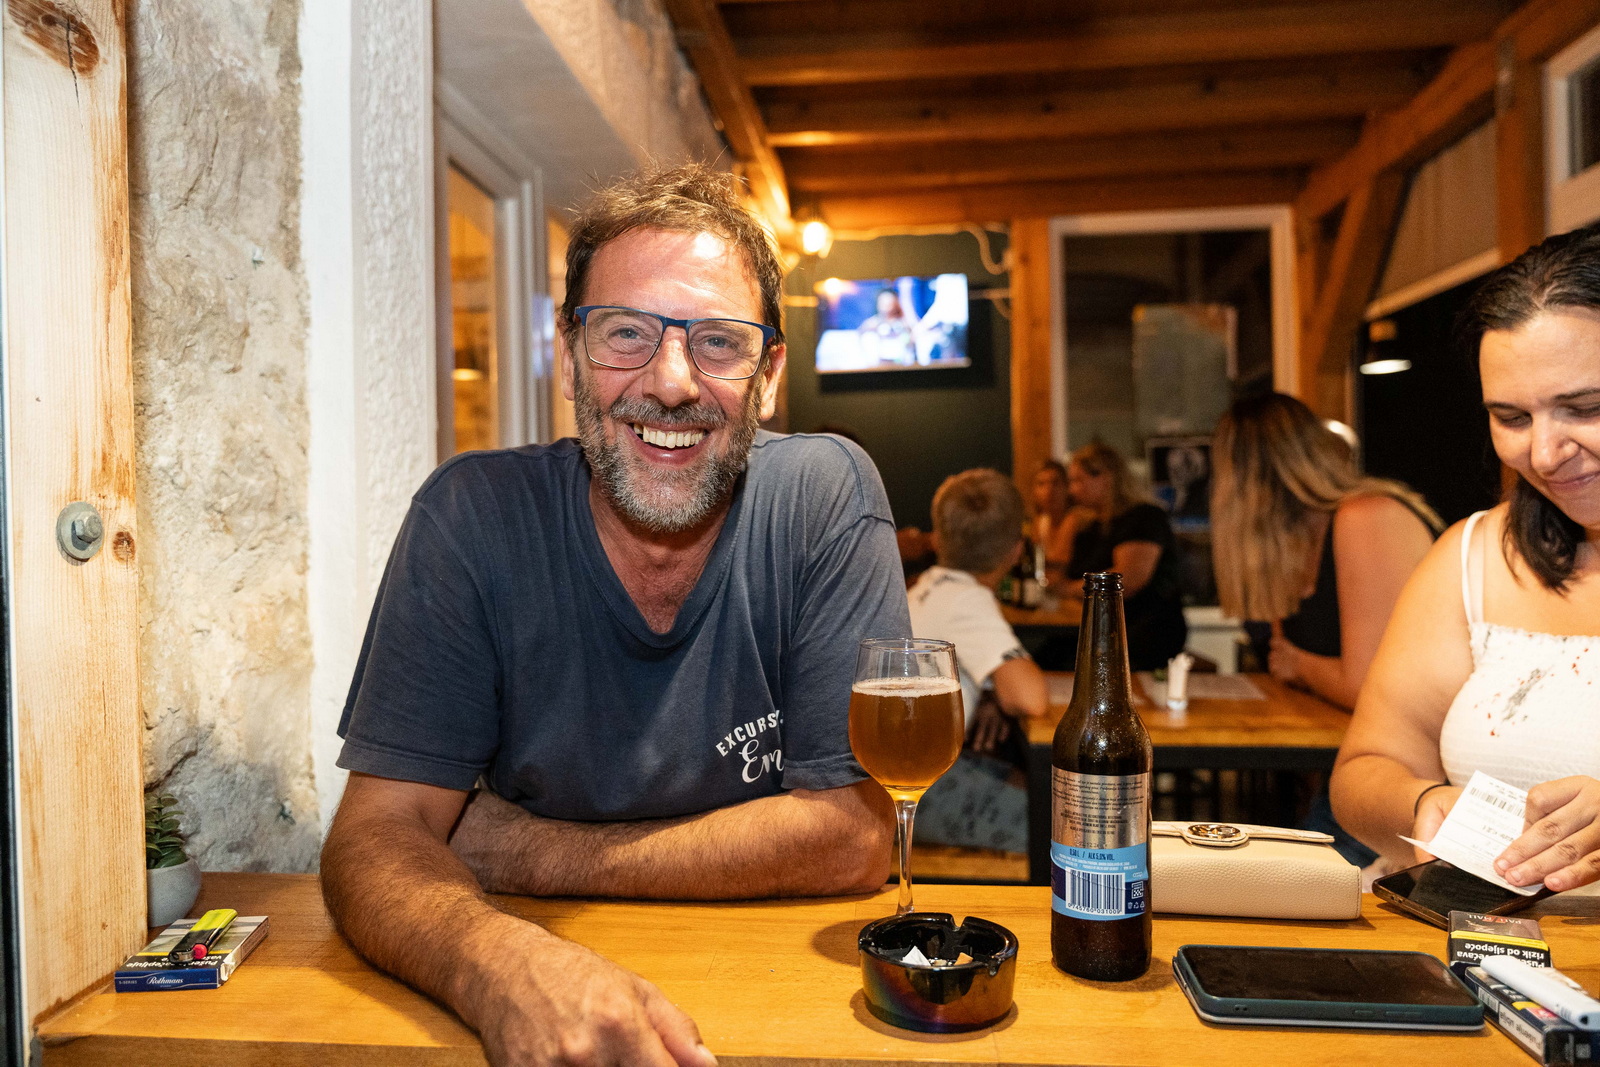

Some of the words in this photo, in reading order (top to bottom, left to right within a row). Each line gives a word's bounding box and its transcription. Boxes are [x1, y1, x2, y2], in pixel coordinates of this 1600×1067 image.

[1464, 942, 1505, 955] sljepoće
[1506, 948, 1520, 956] od
[1522, 950, 1545, 960] rizik
[146, 976, 184, 985] Rothmans
